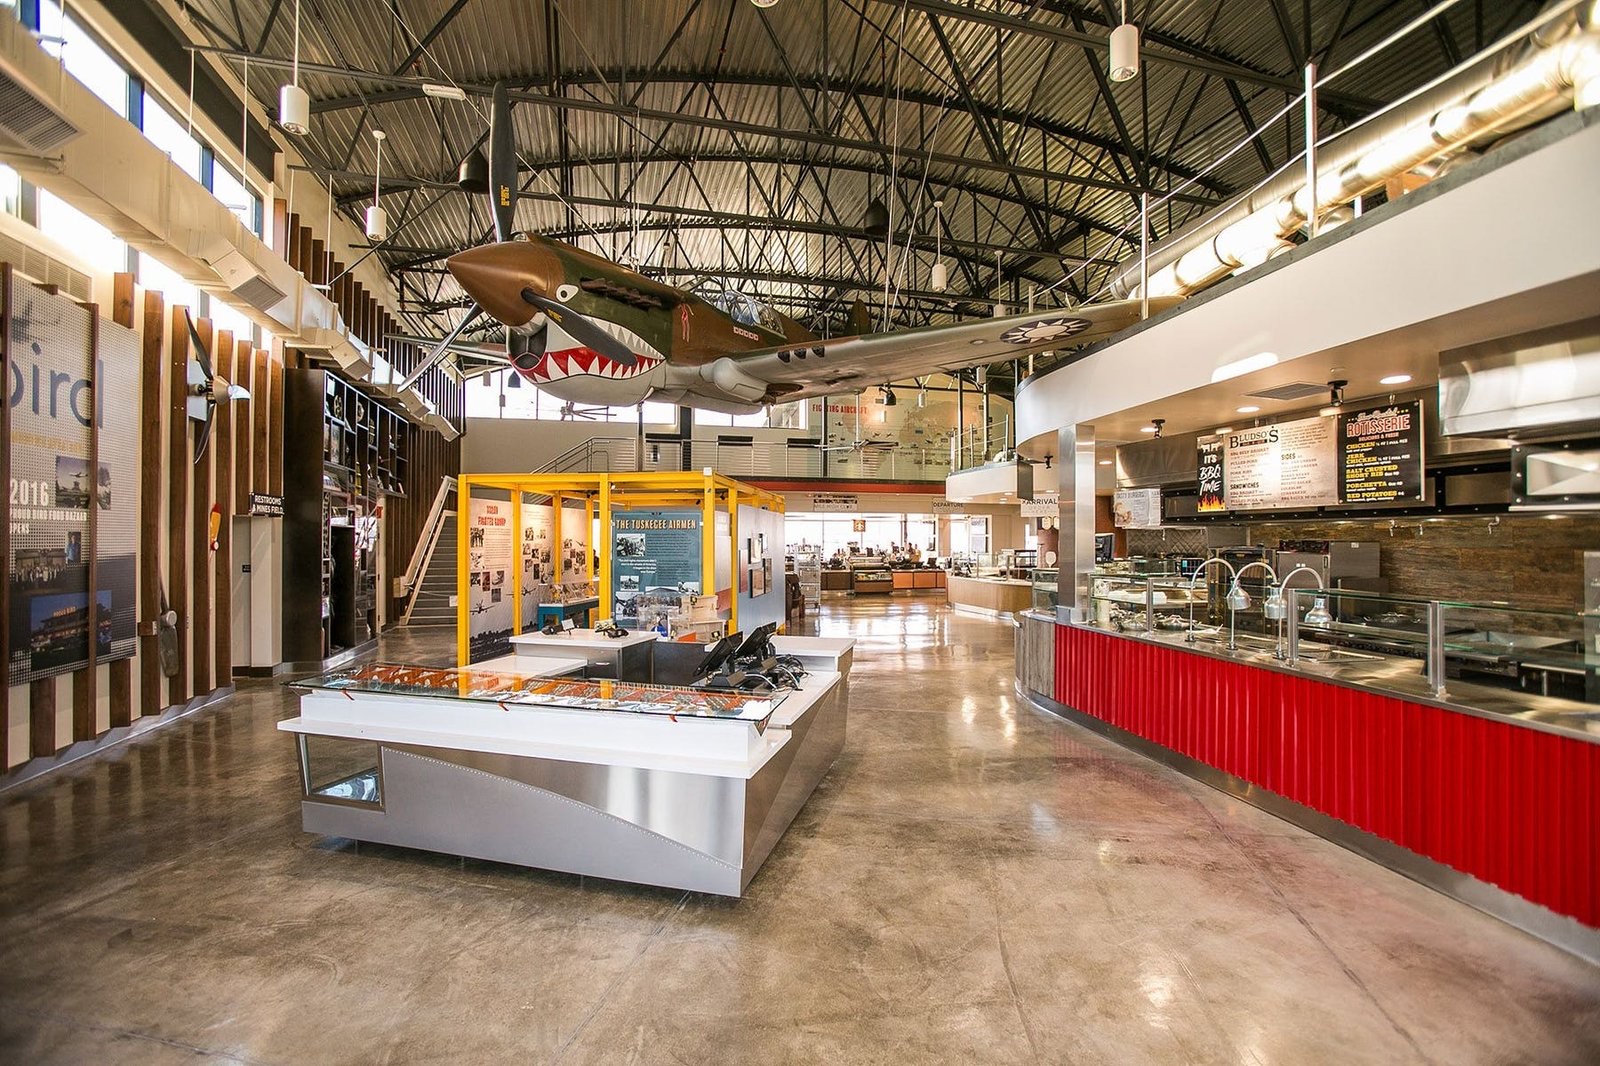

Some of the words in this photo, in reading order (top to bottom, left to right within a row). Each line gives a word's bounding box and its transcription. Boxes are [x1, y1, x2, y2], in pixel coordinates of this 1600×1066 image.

[812, 404, 839, 413] FIGING
[841, 405, 867, 414] AIRCRFT
[1346, 414, 1410, 438] ROTISSERIE
[1346, 441, 1375, 450] CHICKEN
[1281, 453, 1296, 461] SIDES
[1198, 464, 1221, 481] BBQ
[1200, 480, 1222, 496] TIME
[1230, 482, 1259, 490] SANDWICHES
[1346, 481, 1387, 489] PORCHETTA
[10, 479, 49, 506] 2016
[1361, 490, 1397, 498] POTATOES
[255, 495, 281, 505] RESTROOMS
[49, 510, 66, 521] FOOD
[616, 519, 629, 530] THE
[632, 519, 667, 530] TUSKEGEE
[669, 519, 697, 530] AIRMEN
